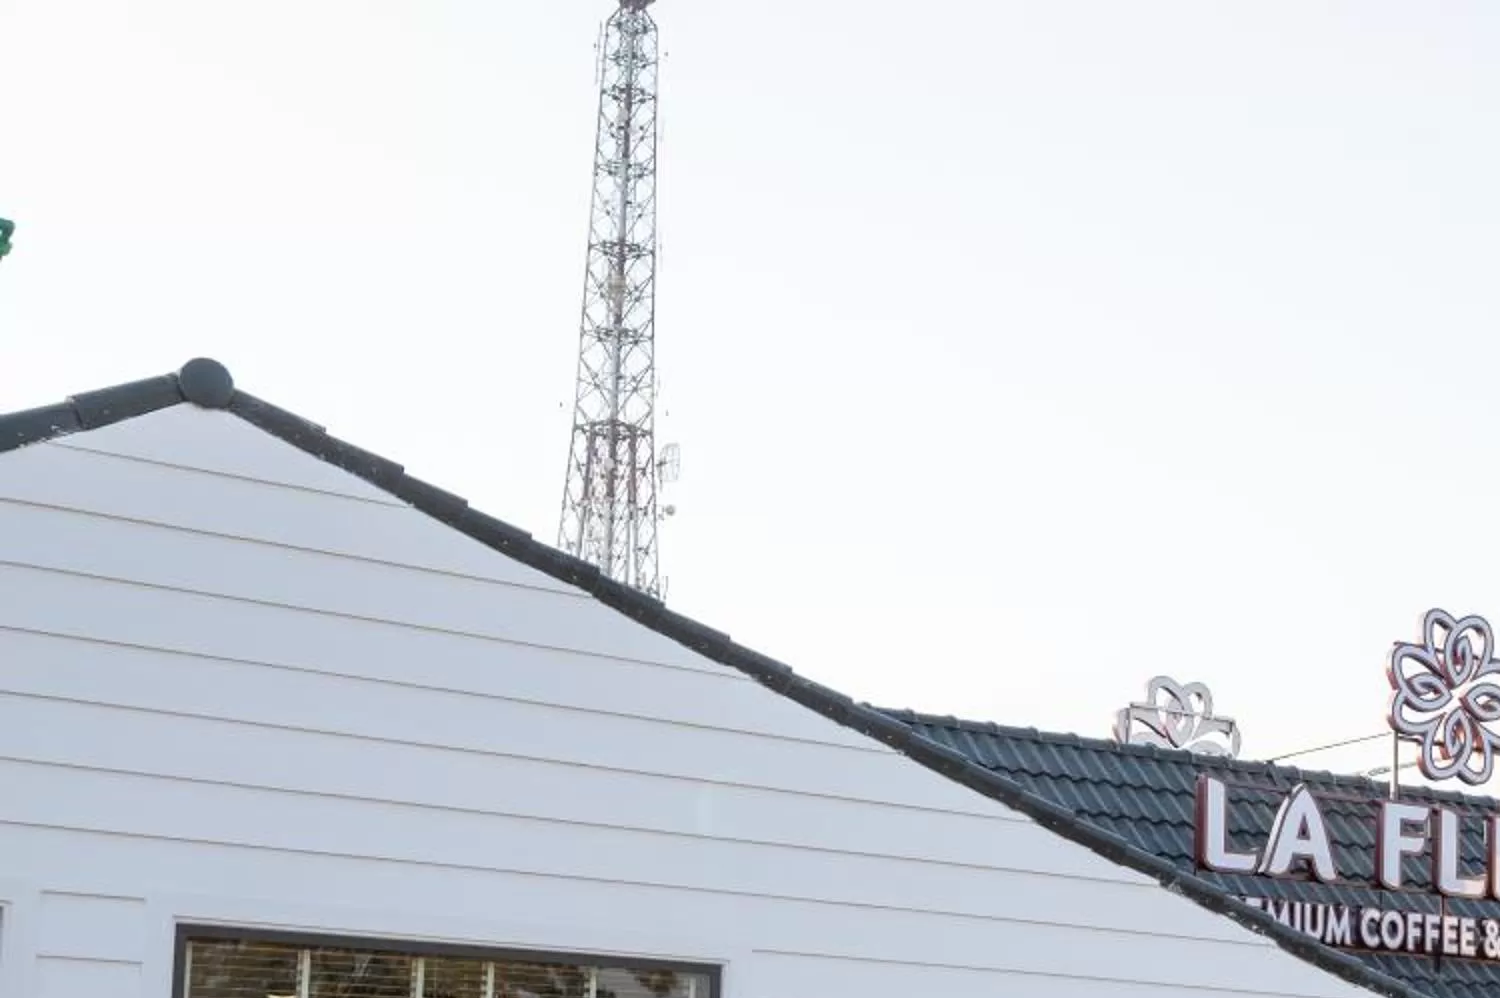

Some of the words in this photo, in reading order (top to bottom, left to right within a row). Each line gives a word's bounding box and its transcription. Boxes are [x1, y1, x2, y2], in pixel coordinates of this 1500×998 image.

[1197, 775, 1338, 882] LA
[1242, 896, 1352, 946] MIUM
[1361, 909, 1478, 957] COFFEE
